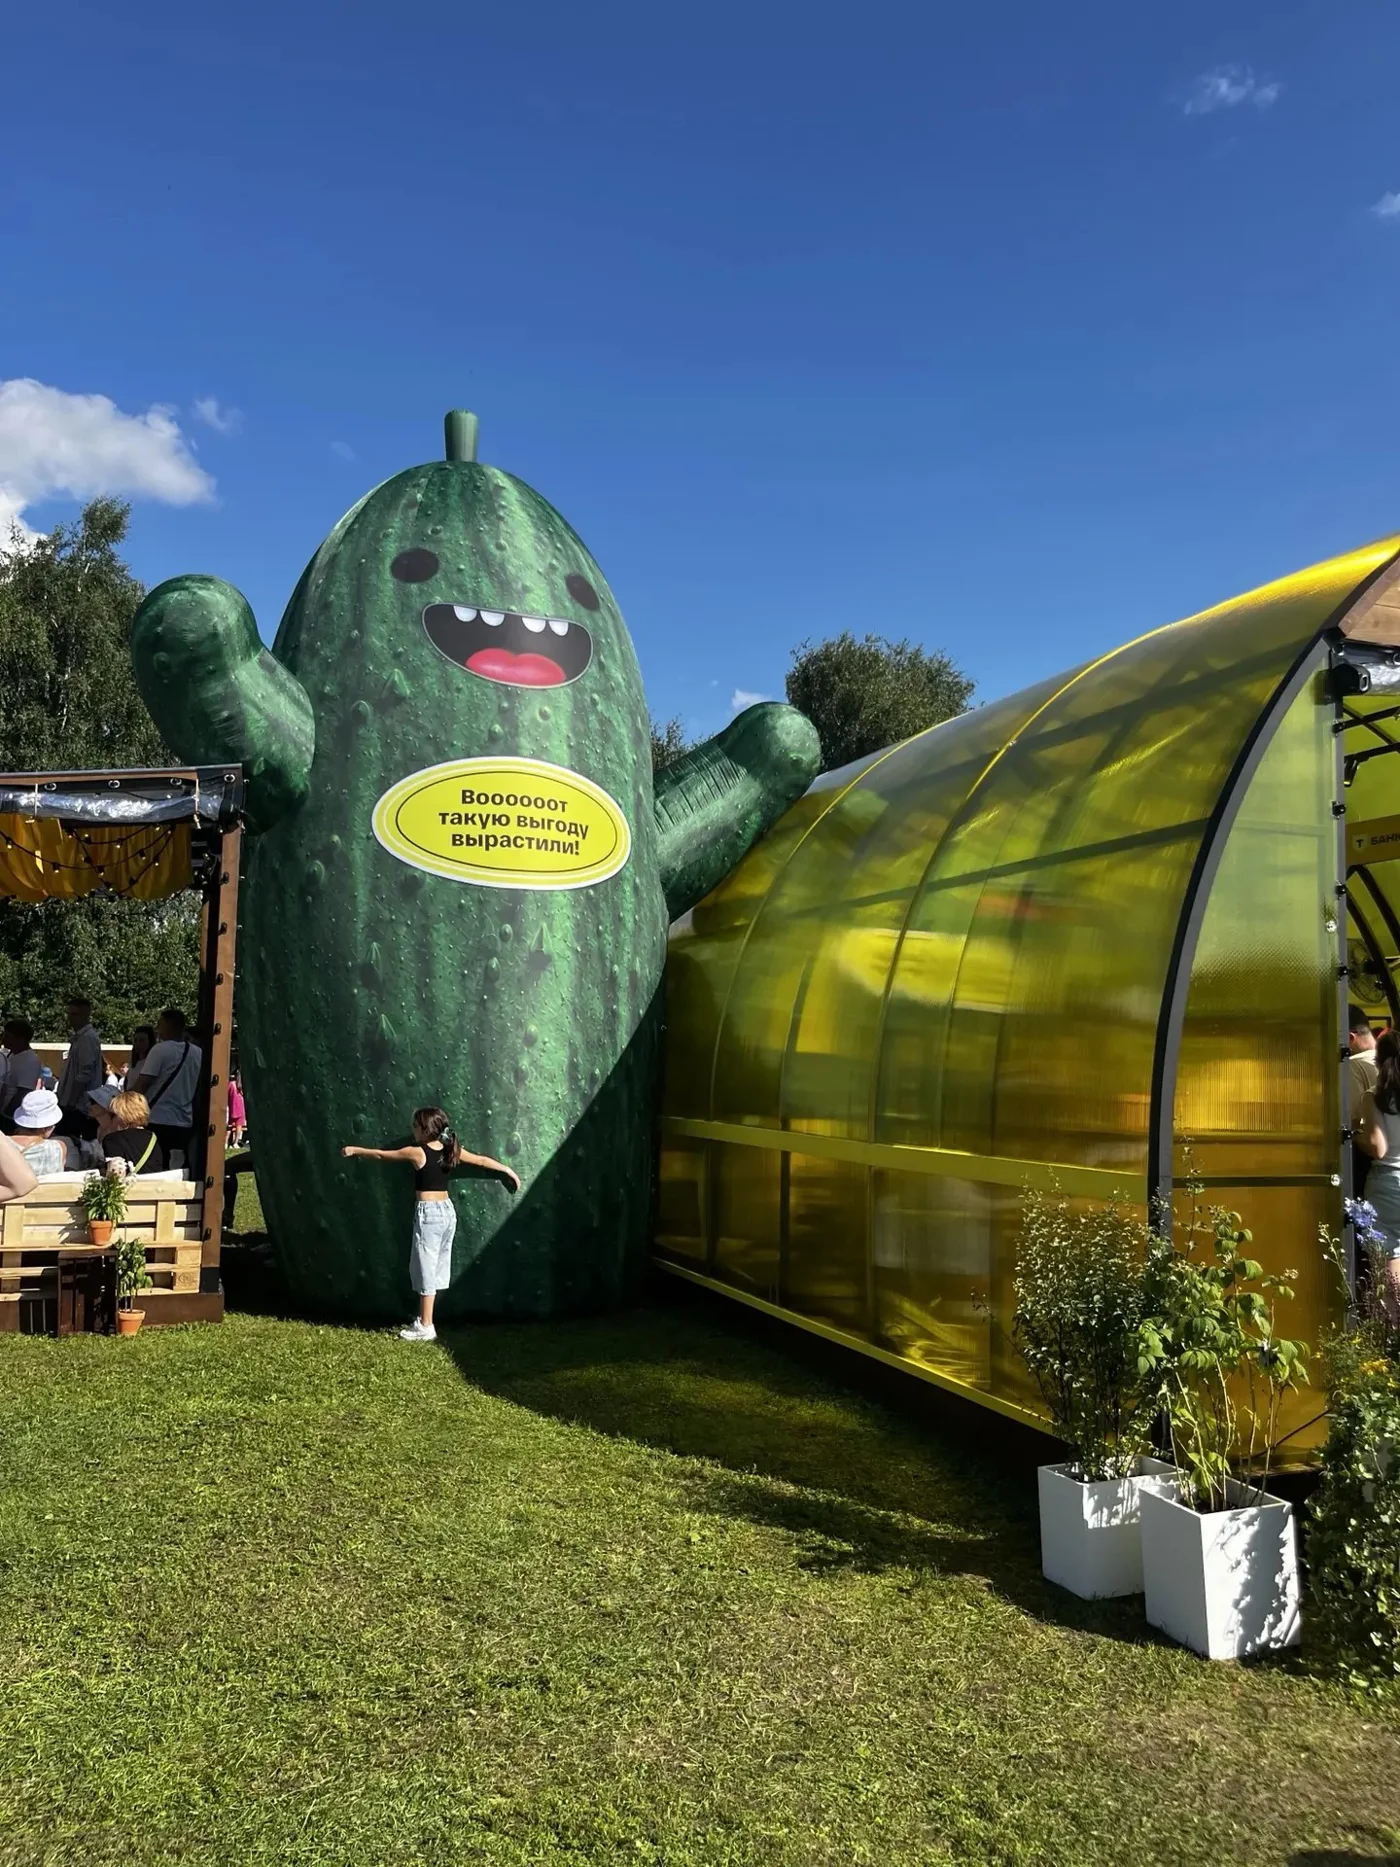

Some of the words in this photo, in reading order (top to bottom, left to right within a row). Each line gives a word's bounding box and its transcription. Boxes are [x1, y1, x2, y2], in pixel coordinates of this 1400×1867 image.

[461, 789, 568, 812] Воооооот
[439, 812, 510, 829] такую
[517, 815, 589, 840] выгоду
[452, 833, 580, 855] вырастили!
